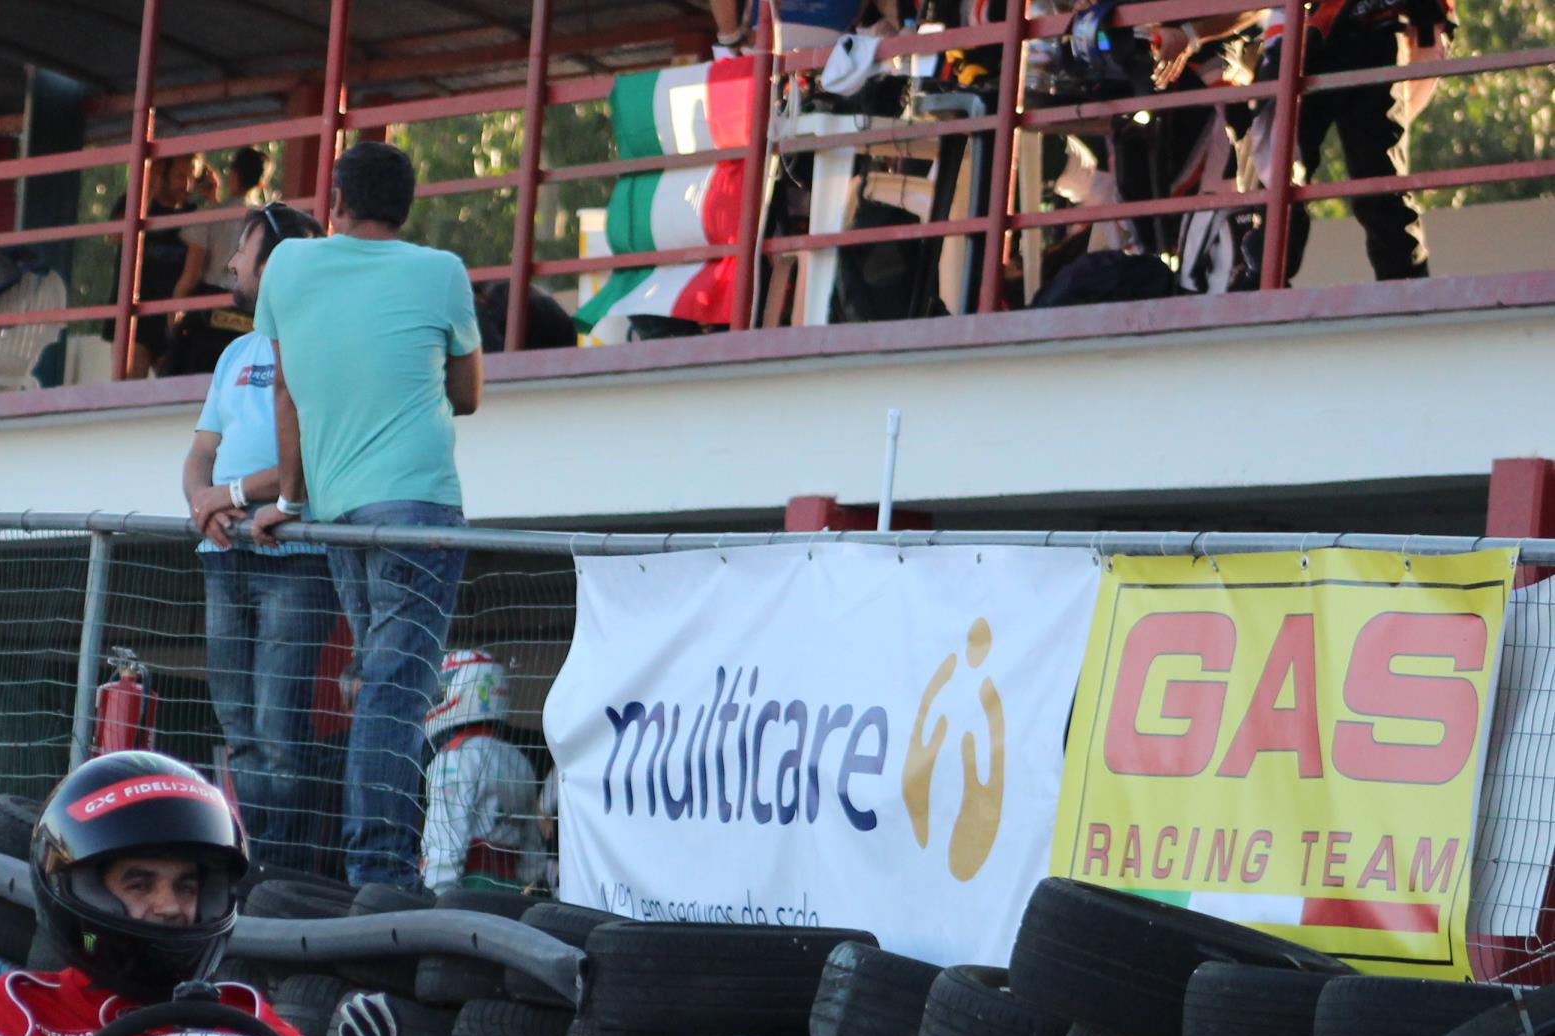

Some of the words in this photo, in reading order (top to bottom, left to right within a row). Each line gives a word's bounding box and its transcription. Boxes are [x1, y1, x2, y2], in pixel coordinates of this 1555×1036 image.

[603, 665, 888, 831] multicare
[1103, 611, 1488, 785] GAS
[1082, 822, 1273, 883] RACING
[1300, 830, 1460, 893] TEAM
